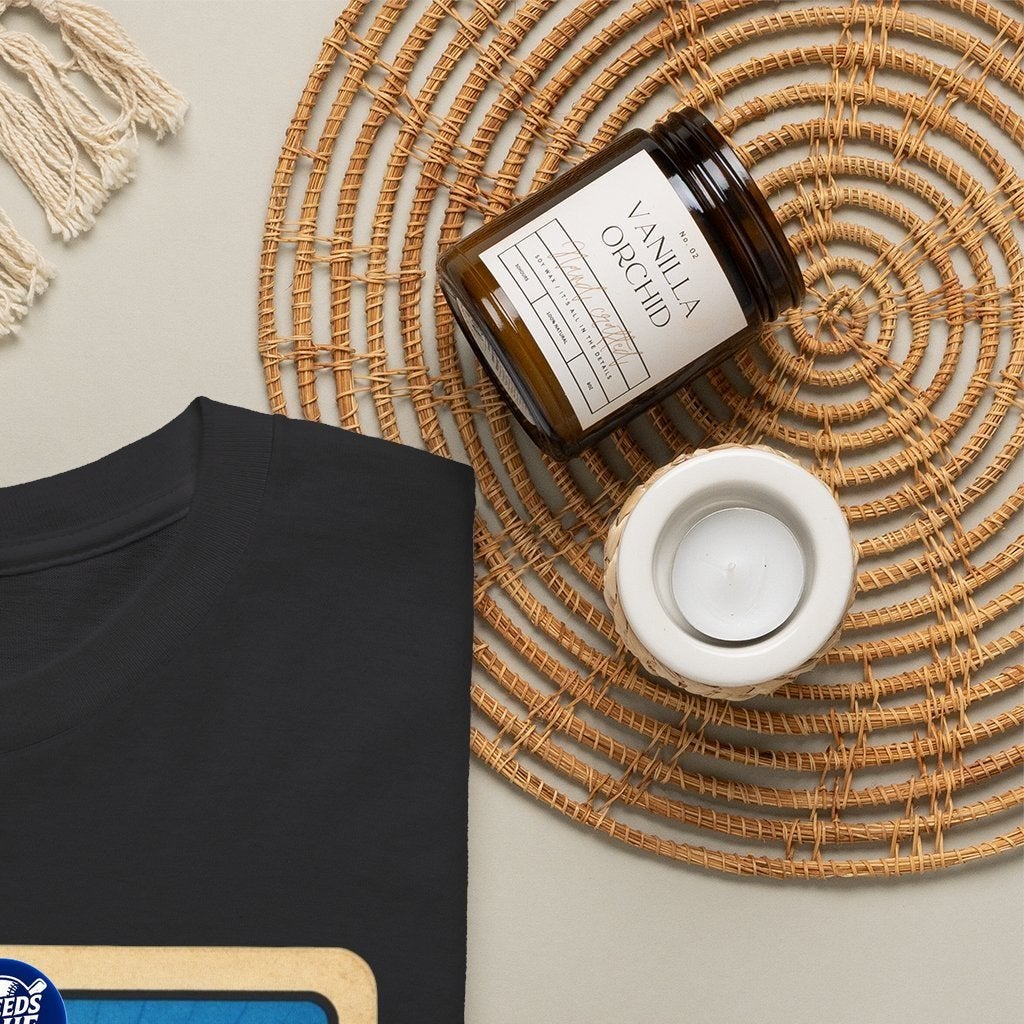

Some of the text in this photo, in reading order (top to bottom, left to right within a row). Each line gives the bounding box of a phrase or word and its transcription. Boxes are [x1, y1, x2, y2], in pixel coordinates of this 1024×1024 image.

[601, 225, 671, 328] ORCHID
[627, 200, 701, 318] VANILLA
[678, 231, 699, 259] No. 02
[535, 254, 545, 266] SOY
[545, 269, 556, 282] WAX
[559, 290, 570, 306] IT'S
[570, 309, 580, 322] ALL
[579, 324, 587, 334] IN
[586, 335, 597, 349] THE
[594, 350, 613, 380] DETAILS
